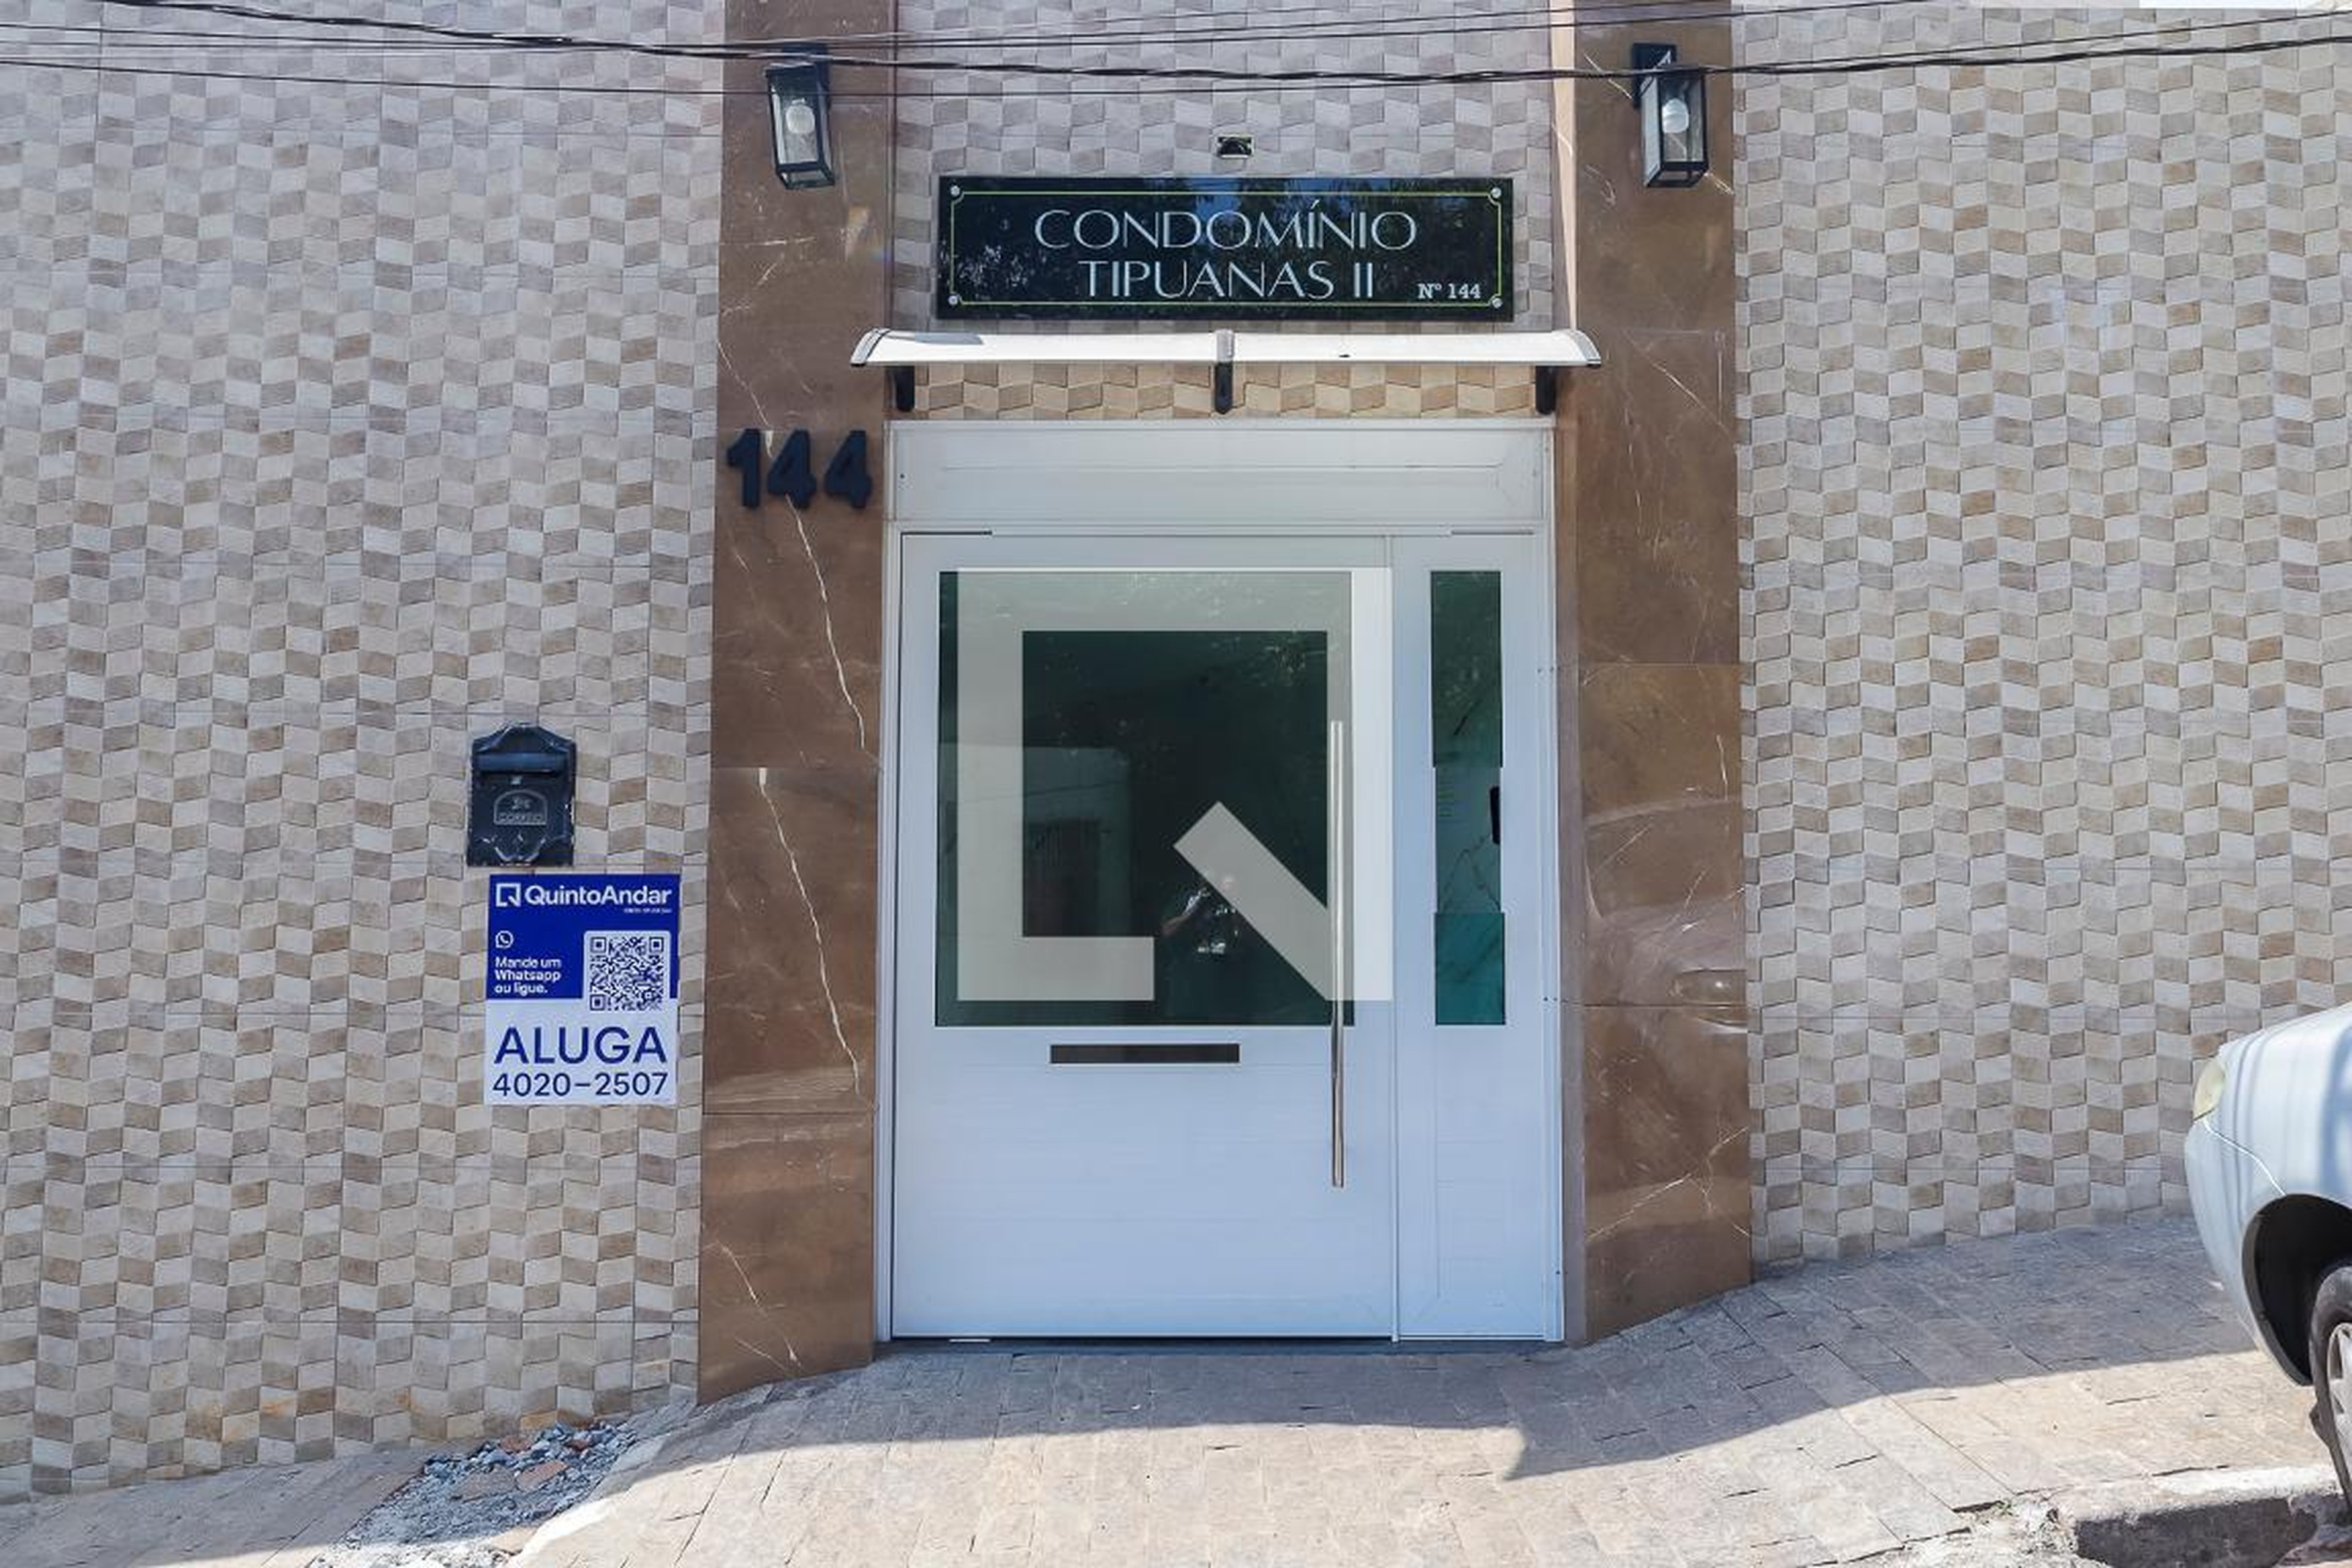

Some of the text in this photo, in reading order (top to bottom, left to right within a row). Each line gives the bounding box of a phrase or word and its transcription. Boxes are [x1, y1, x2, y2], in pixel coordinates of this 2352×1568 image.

[1035, 200, 1416, 250] CONDOMÍNIO
[1078, 260, 1373, 299] TIPUANAS II
[1448, 283, 1481, 299] 144
[726, 428, 872, 509] 144
[525, 885, 672, 905] QuintoAndar
[496, 956, 562, 968] Mande um
[494, 970, 562, 983] Whatsapp
[494, 981, 548, 997] ou ligue.
[494, 1026, 667, 1064] ALUGA
[492, 1072, 668, 1096] 4020-2507
